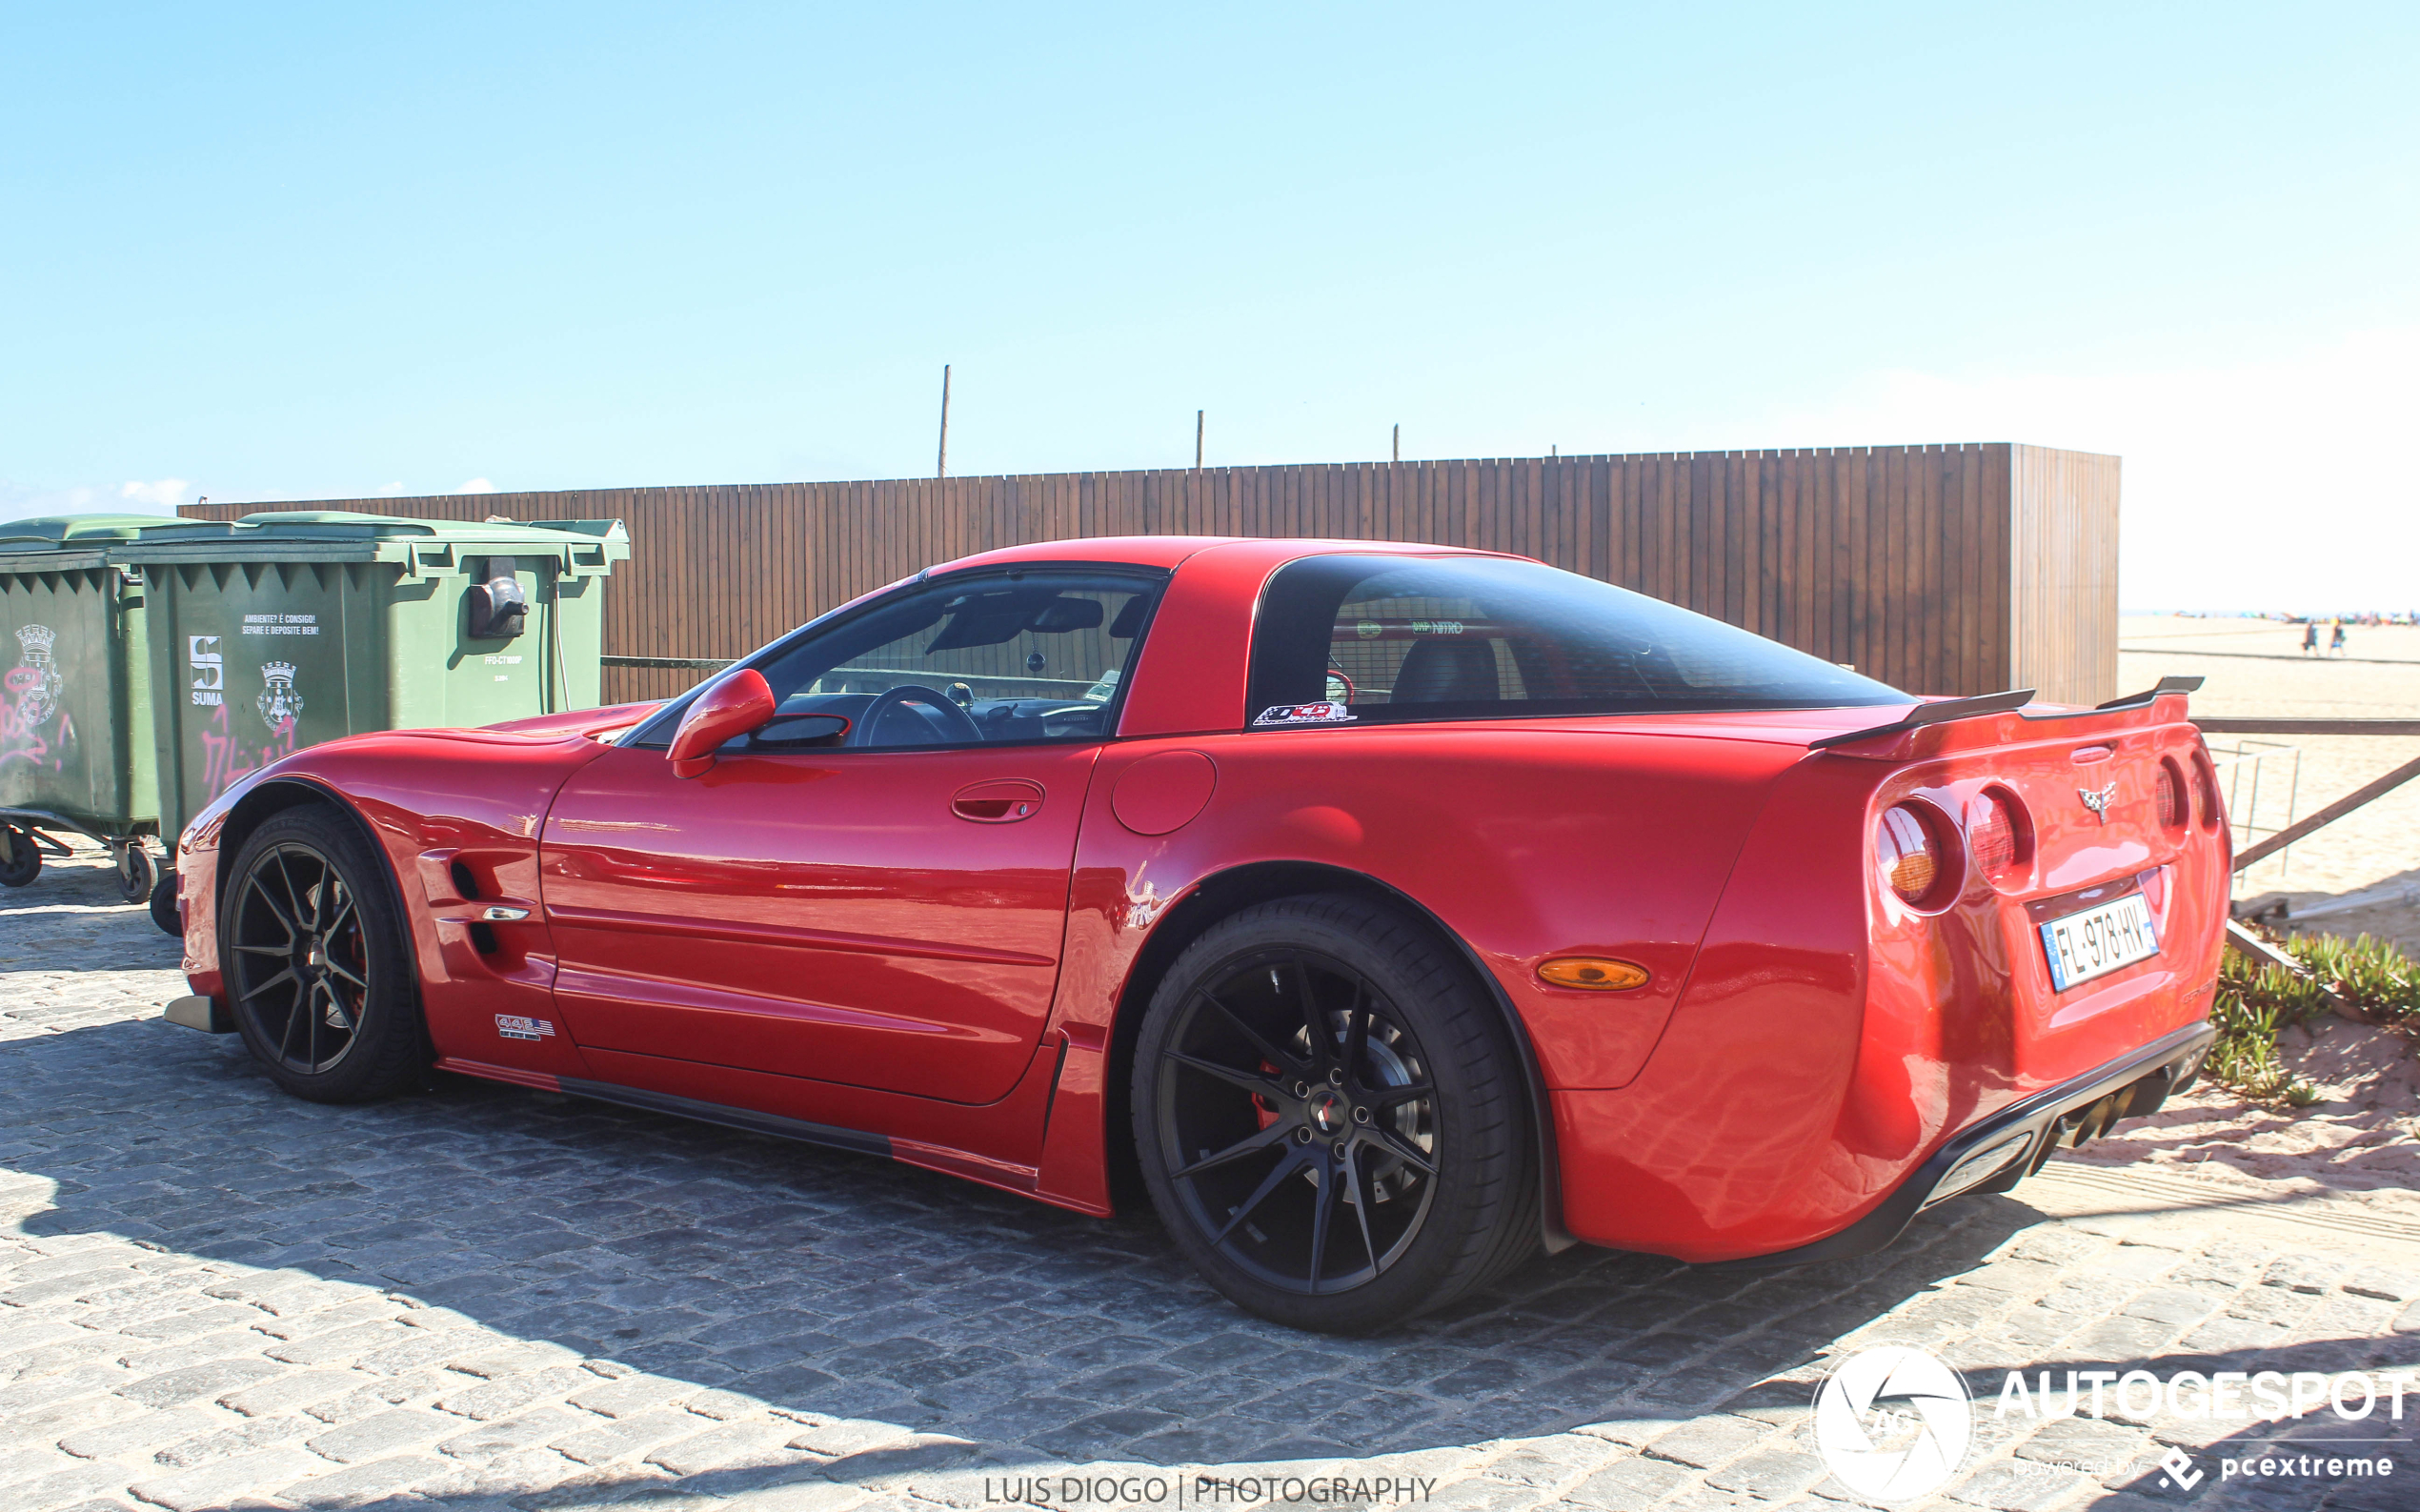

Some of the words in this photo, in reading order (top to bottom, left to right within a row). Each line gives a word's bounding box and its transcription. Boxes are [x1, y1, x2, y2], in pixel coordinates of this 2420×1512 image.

[244, 615, 277, 624] AMBIENTE?
[279, 613, 284, 624] É
[285, 615, 316, 624] CONSIGO!
[242, 626, 264, 635] SEPARE
[265, 626, 270, 635] E
[271, 626, 301, 635] DEPOSITE
[302, 626, 319, 635] BEM!
[1432, 621, 1464, 635] NITRO
[192, 692, 223, 706] SUMA
[2056, 903, 2144, 978] FL-978-HV
[498, 1018, 534, 1031] 442
